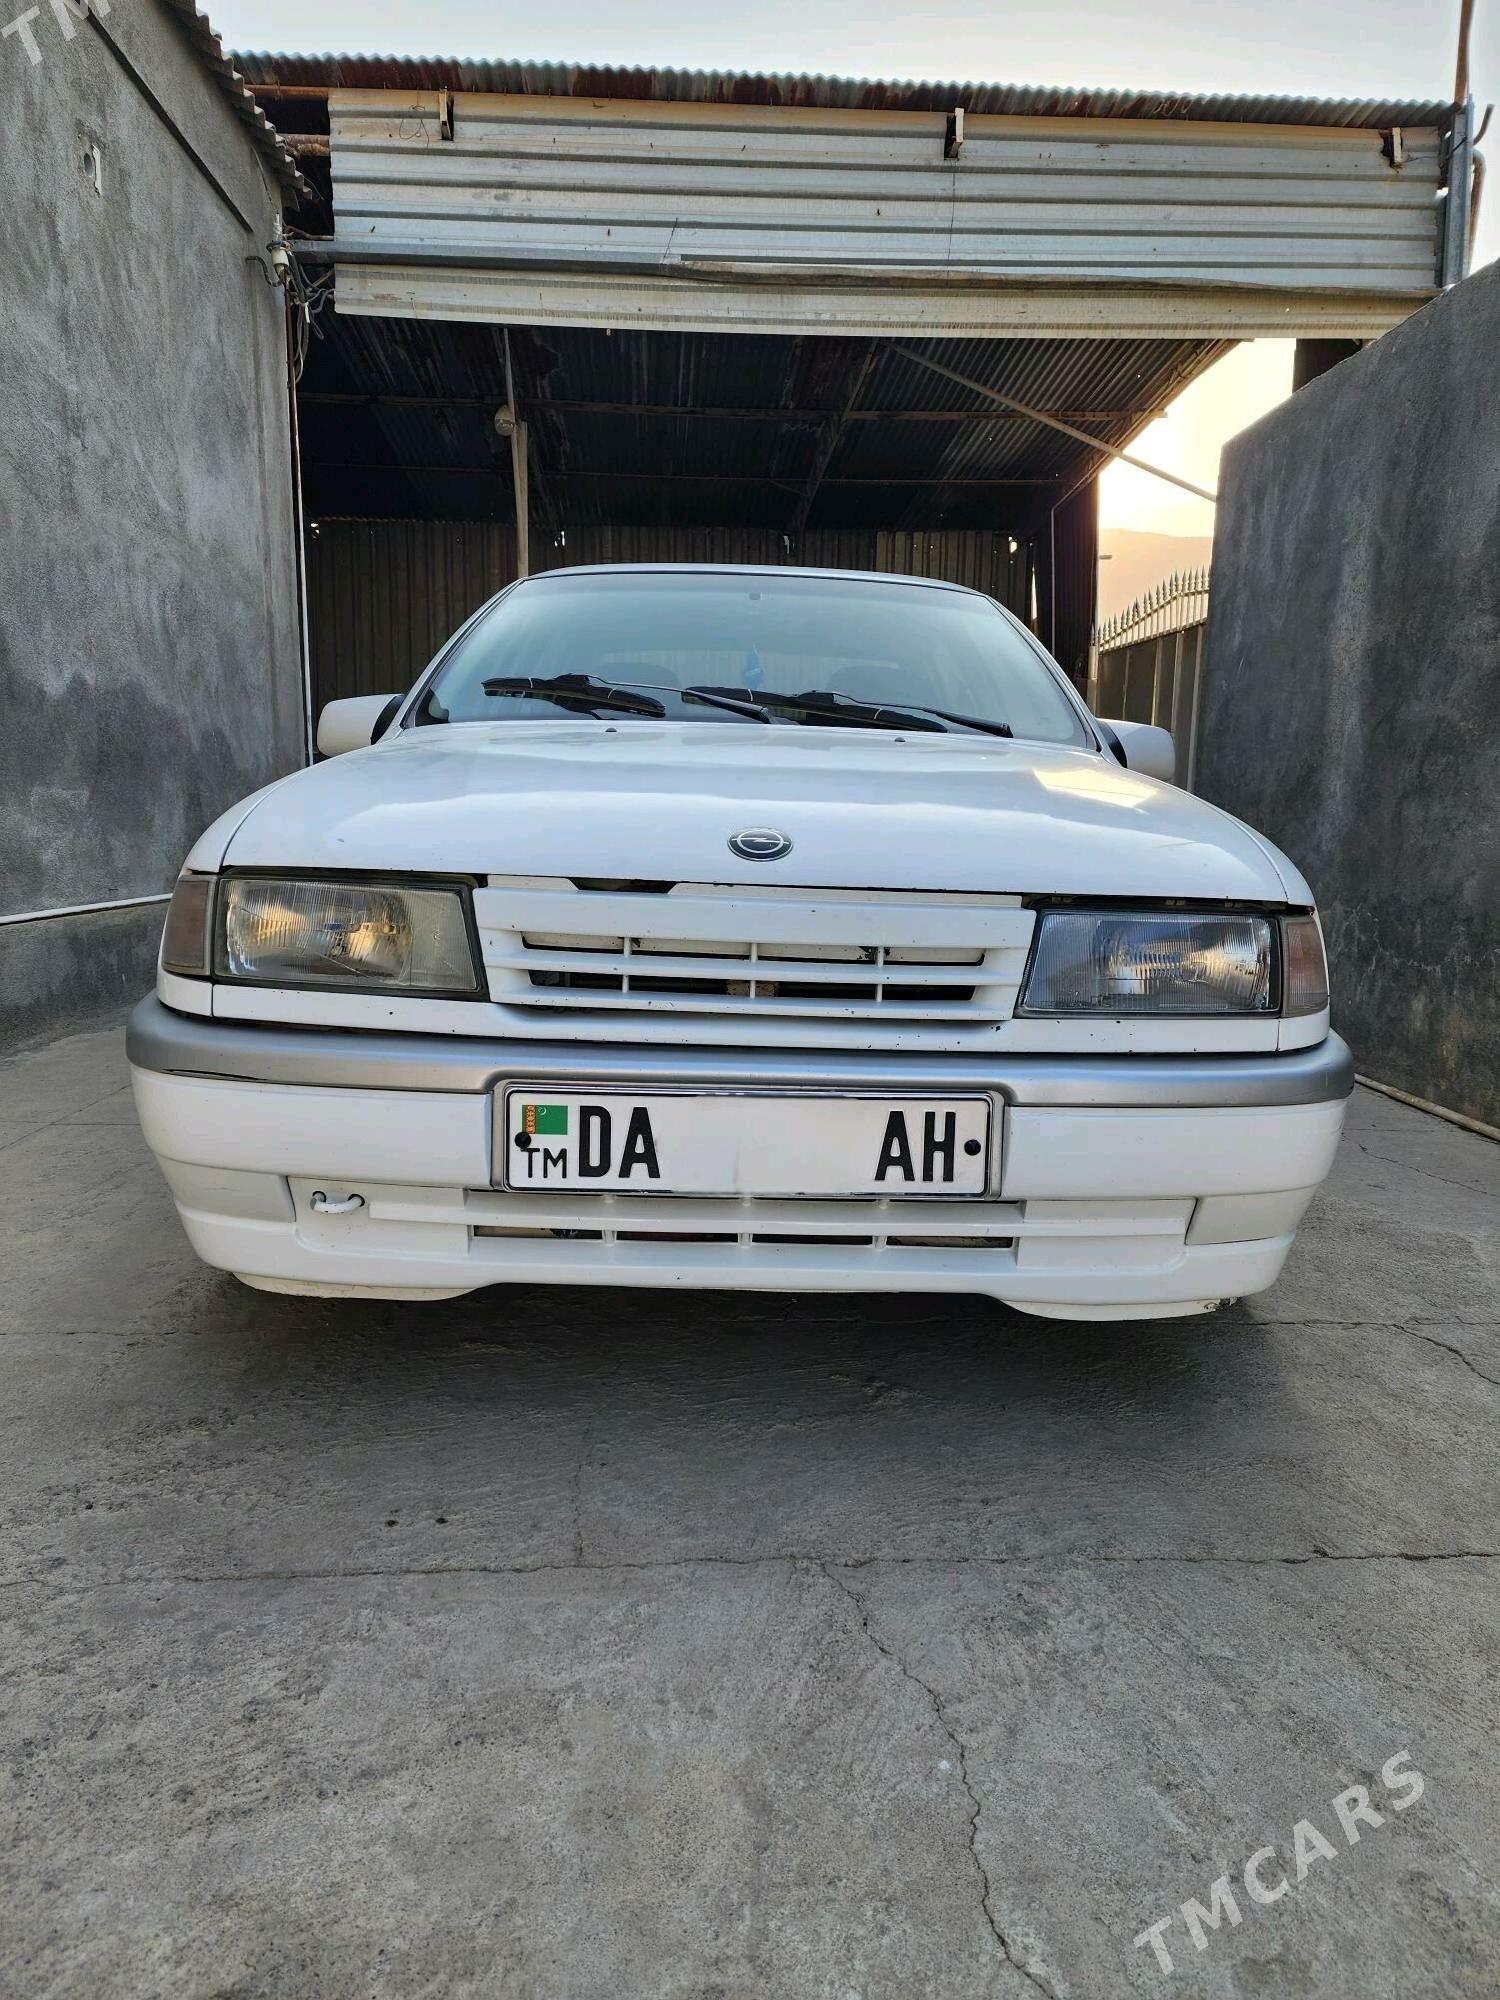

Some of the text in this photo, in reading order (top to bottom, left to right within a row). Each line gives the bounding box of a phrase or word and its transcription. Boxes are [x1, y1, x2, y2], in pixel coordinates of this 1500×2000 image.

[523, 1147, 567, 1179] TM
[578, 1105, 957, 1182] DA AH
